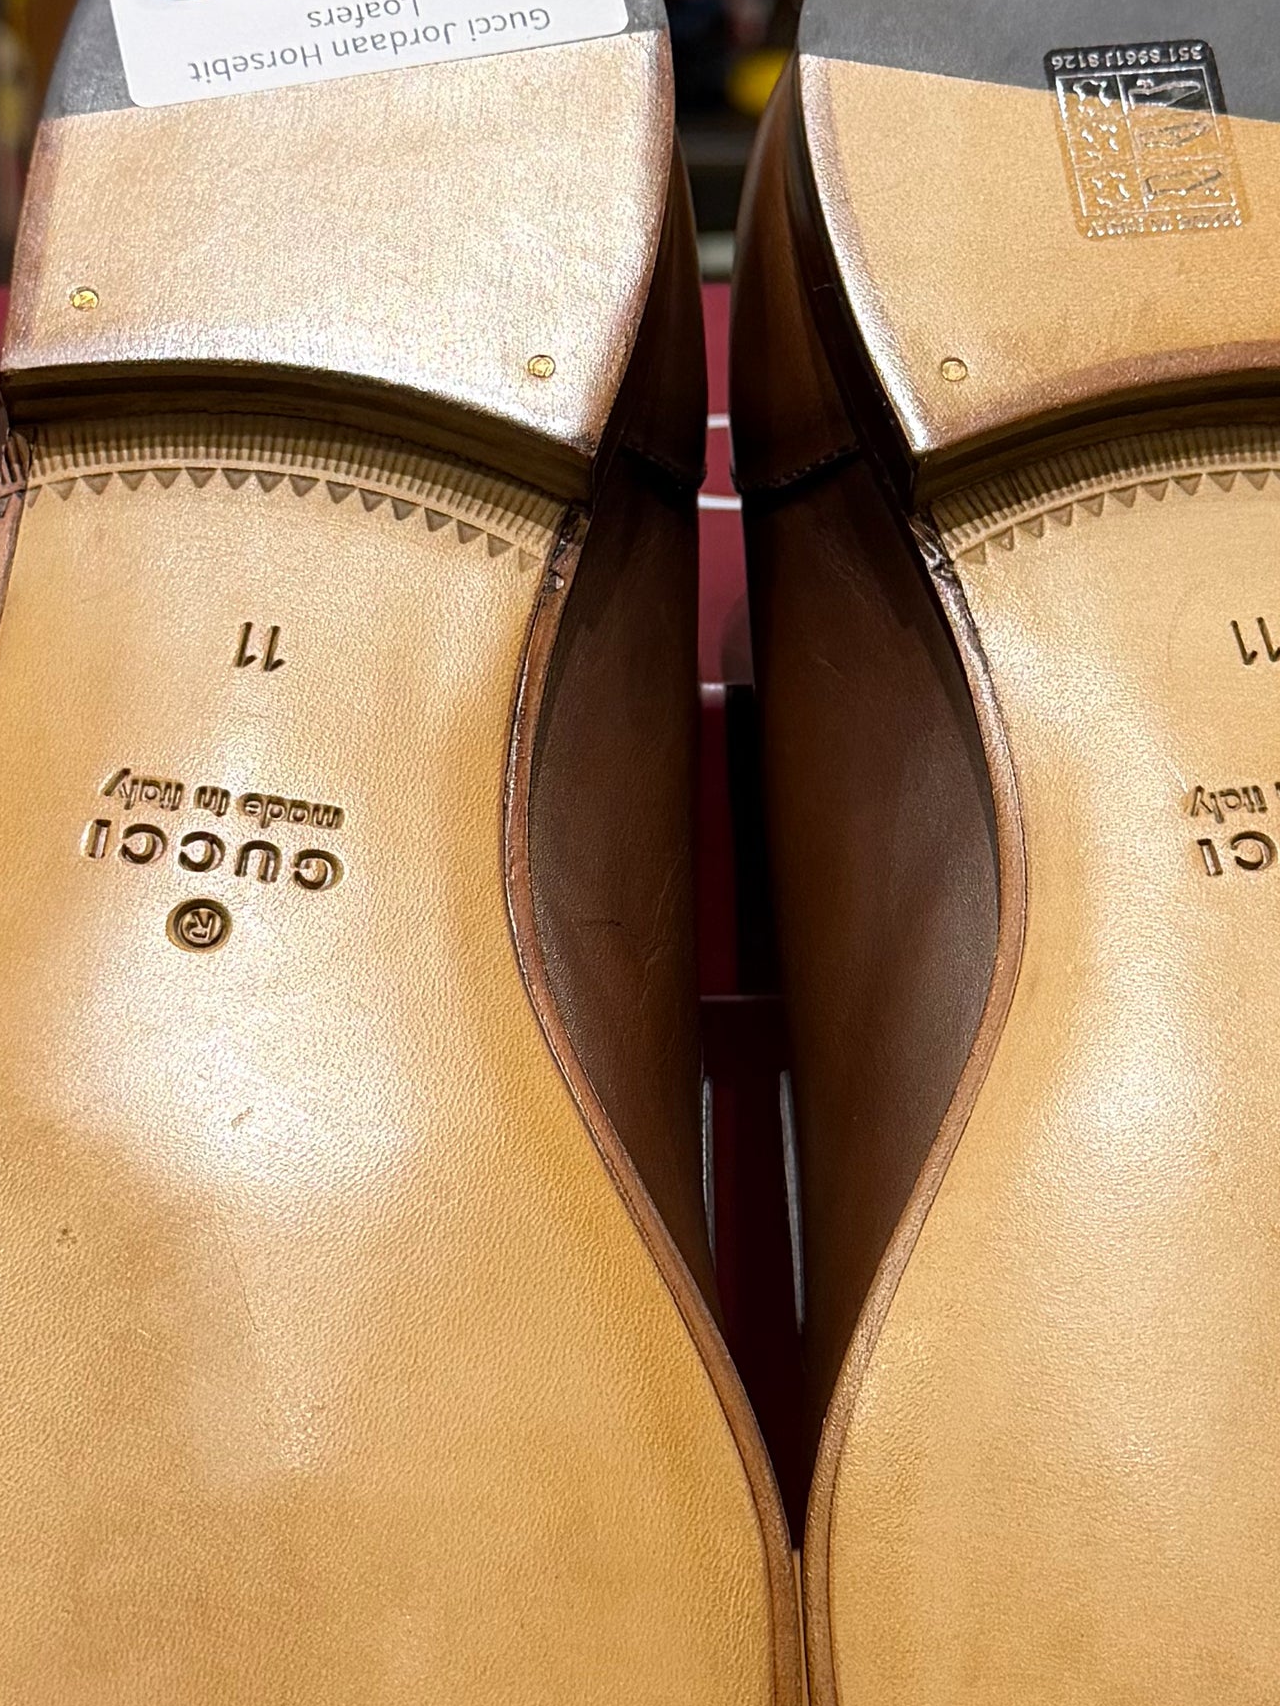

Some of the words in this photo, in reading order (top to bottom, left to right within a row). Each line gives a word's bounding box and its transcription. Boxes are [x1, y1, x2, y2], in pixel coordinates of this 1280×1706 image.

[331, 20, 456, 58] Jordaan
[467, 6, 551, 42] Gucci
[188, 43, 322, 84] Horsebit
[232, 622, 286, 673] 11
[194, 786, 231, 817] in
[240, 793, 345, 831] made
[85, 819, 345, 893] GUCCI
